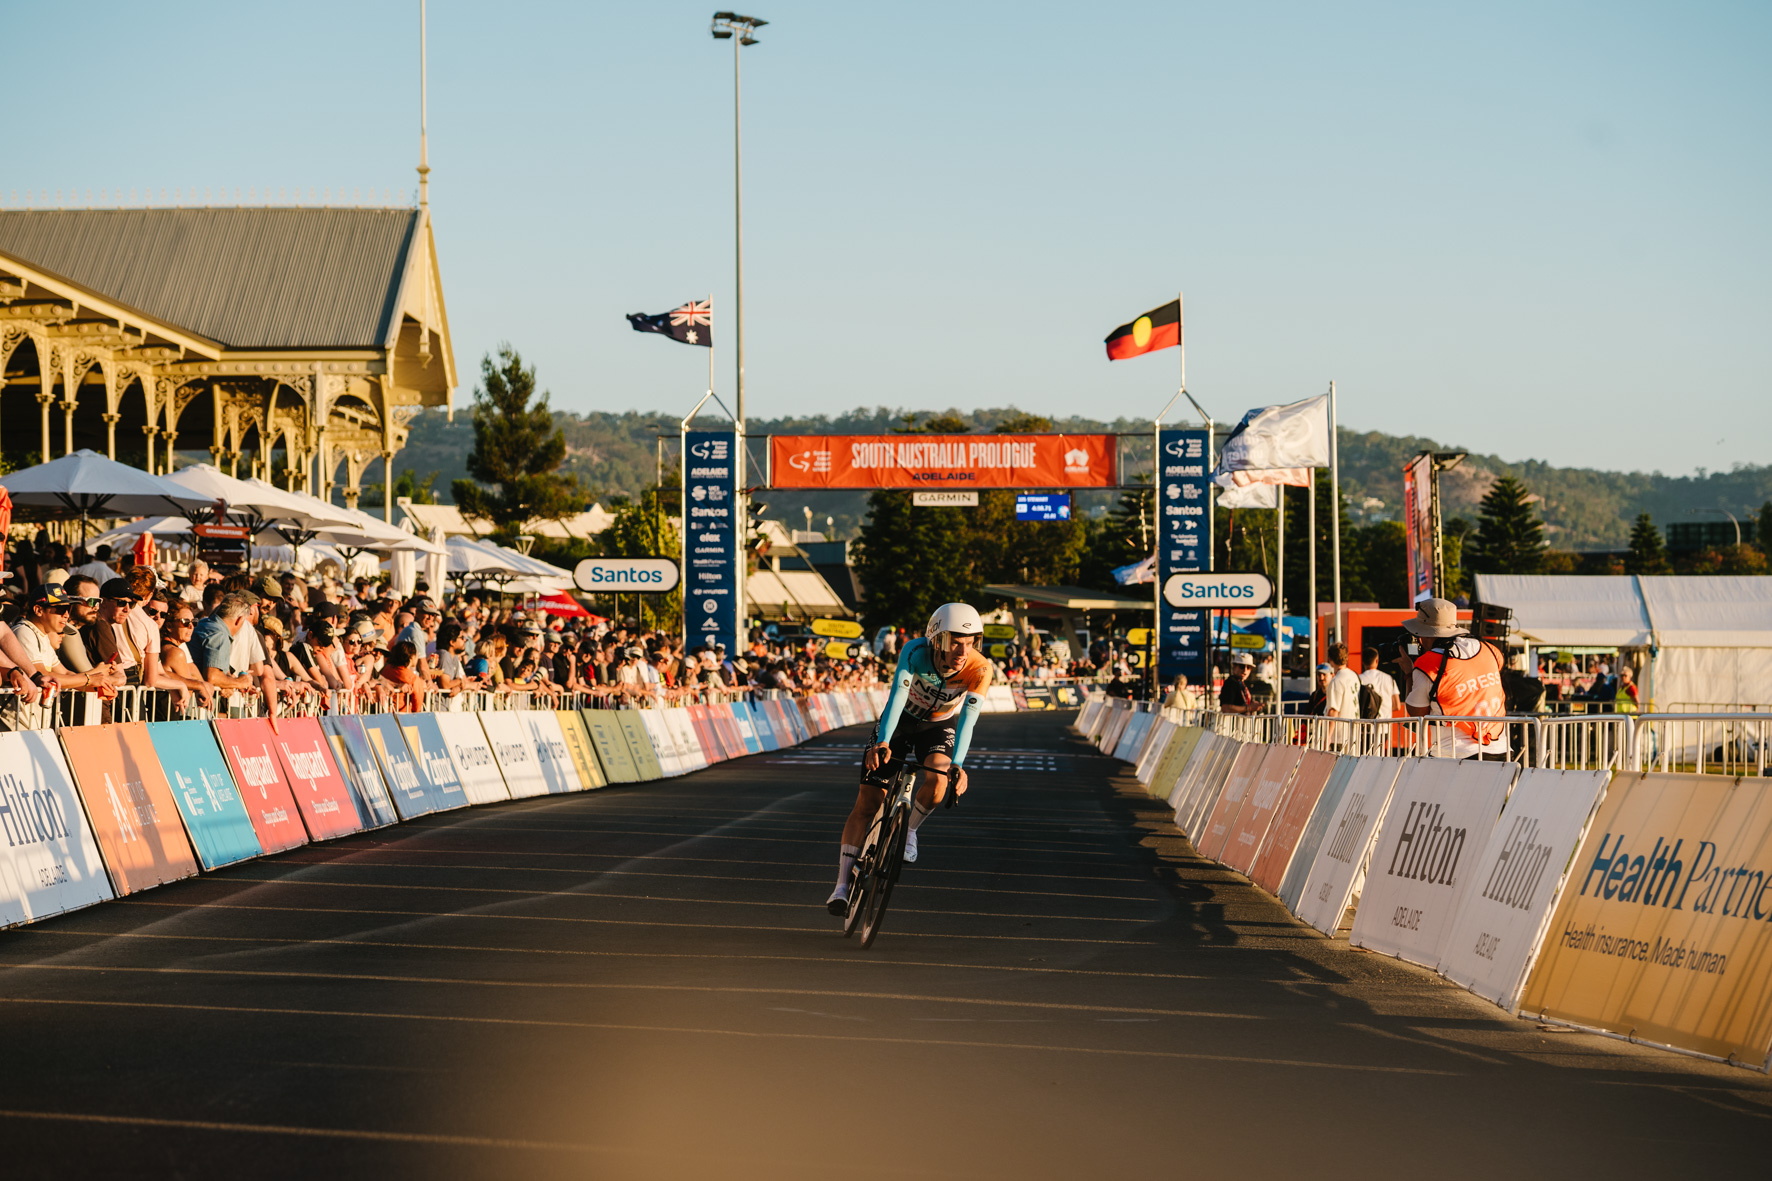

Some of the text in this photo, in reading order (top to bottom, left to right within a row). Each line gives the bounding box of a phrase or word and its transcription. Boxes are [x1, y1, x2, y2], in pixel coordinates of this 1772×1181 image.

[852, 442, 1036, 468] SOUTH AUSTRALIA PROLOGUE
[918, 494, 971, 502] GARMIN
[1166, 505, 1202, 516] Santos
[691, 506, 728, 517] Santos
[591, 566, 663, 582] Santos
[698, 572, 722, 580] Hilton
[1181, 582, 1254, 598] Santos
[1455, 671, 1500, 698] PRESS
[232, 744, 280, 800] Vanguard
[281, 740, 331, 792] Vanguard
[1327, 792, 1368, 864] Hilton
[1388, 801, 1466, 886] Hilton
[1482, 816, 1552, 911] Hilton
[1391, 906, 1423, 932] ADELAIDE
[1560, 921, 1726, 976] Health insurance. Made human.
